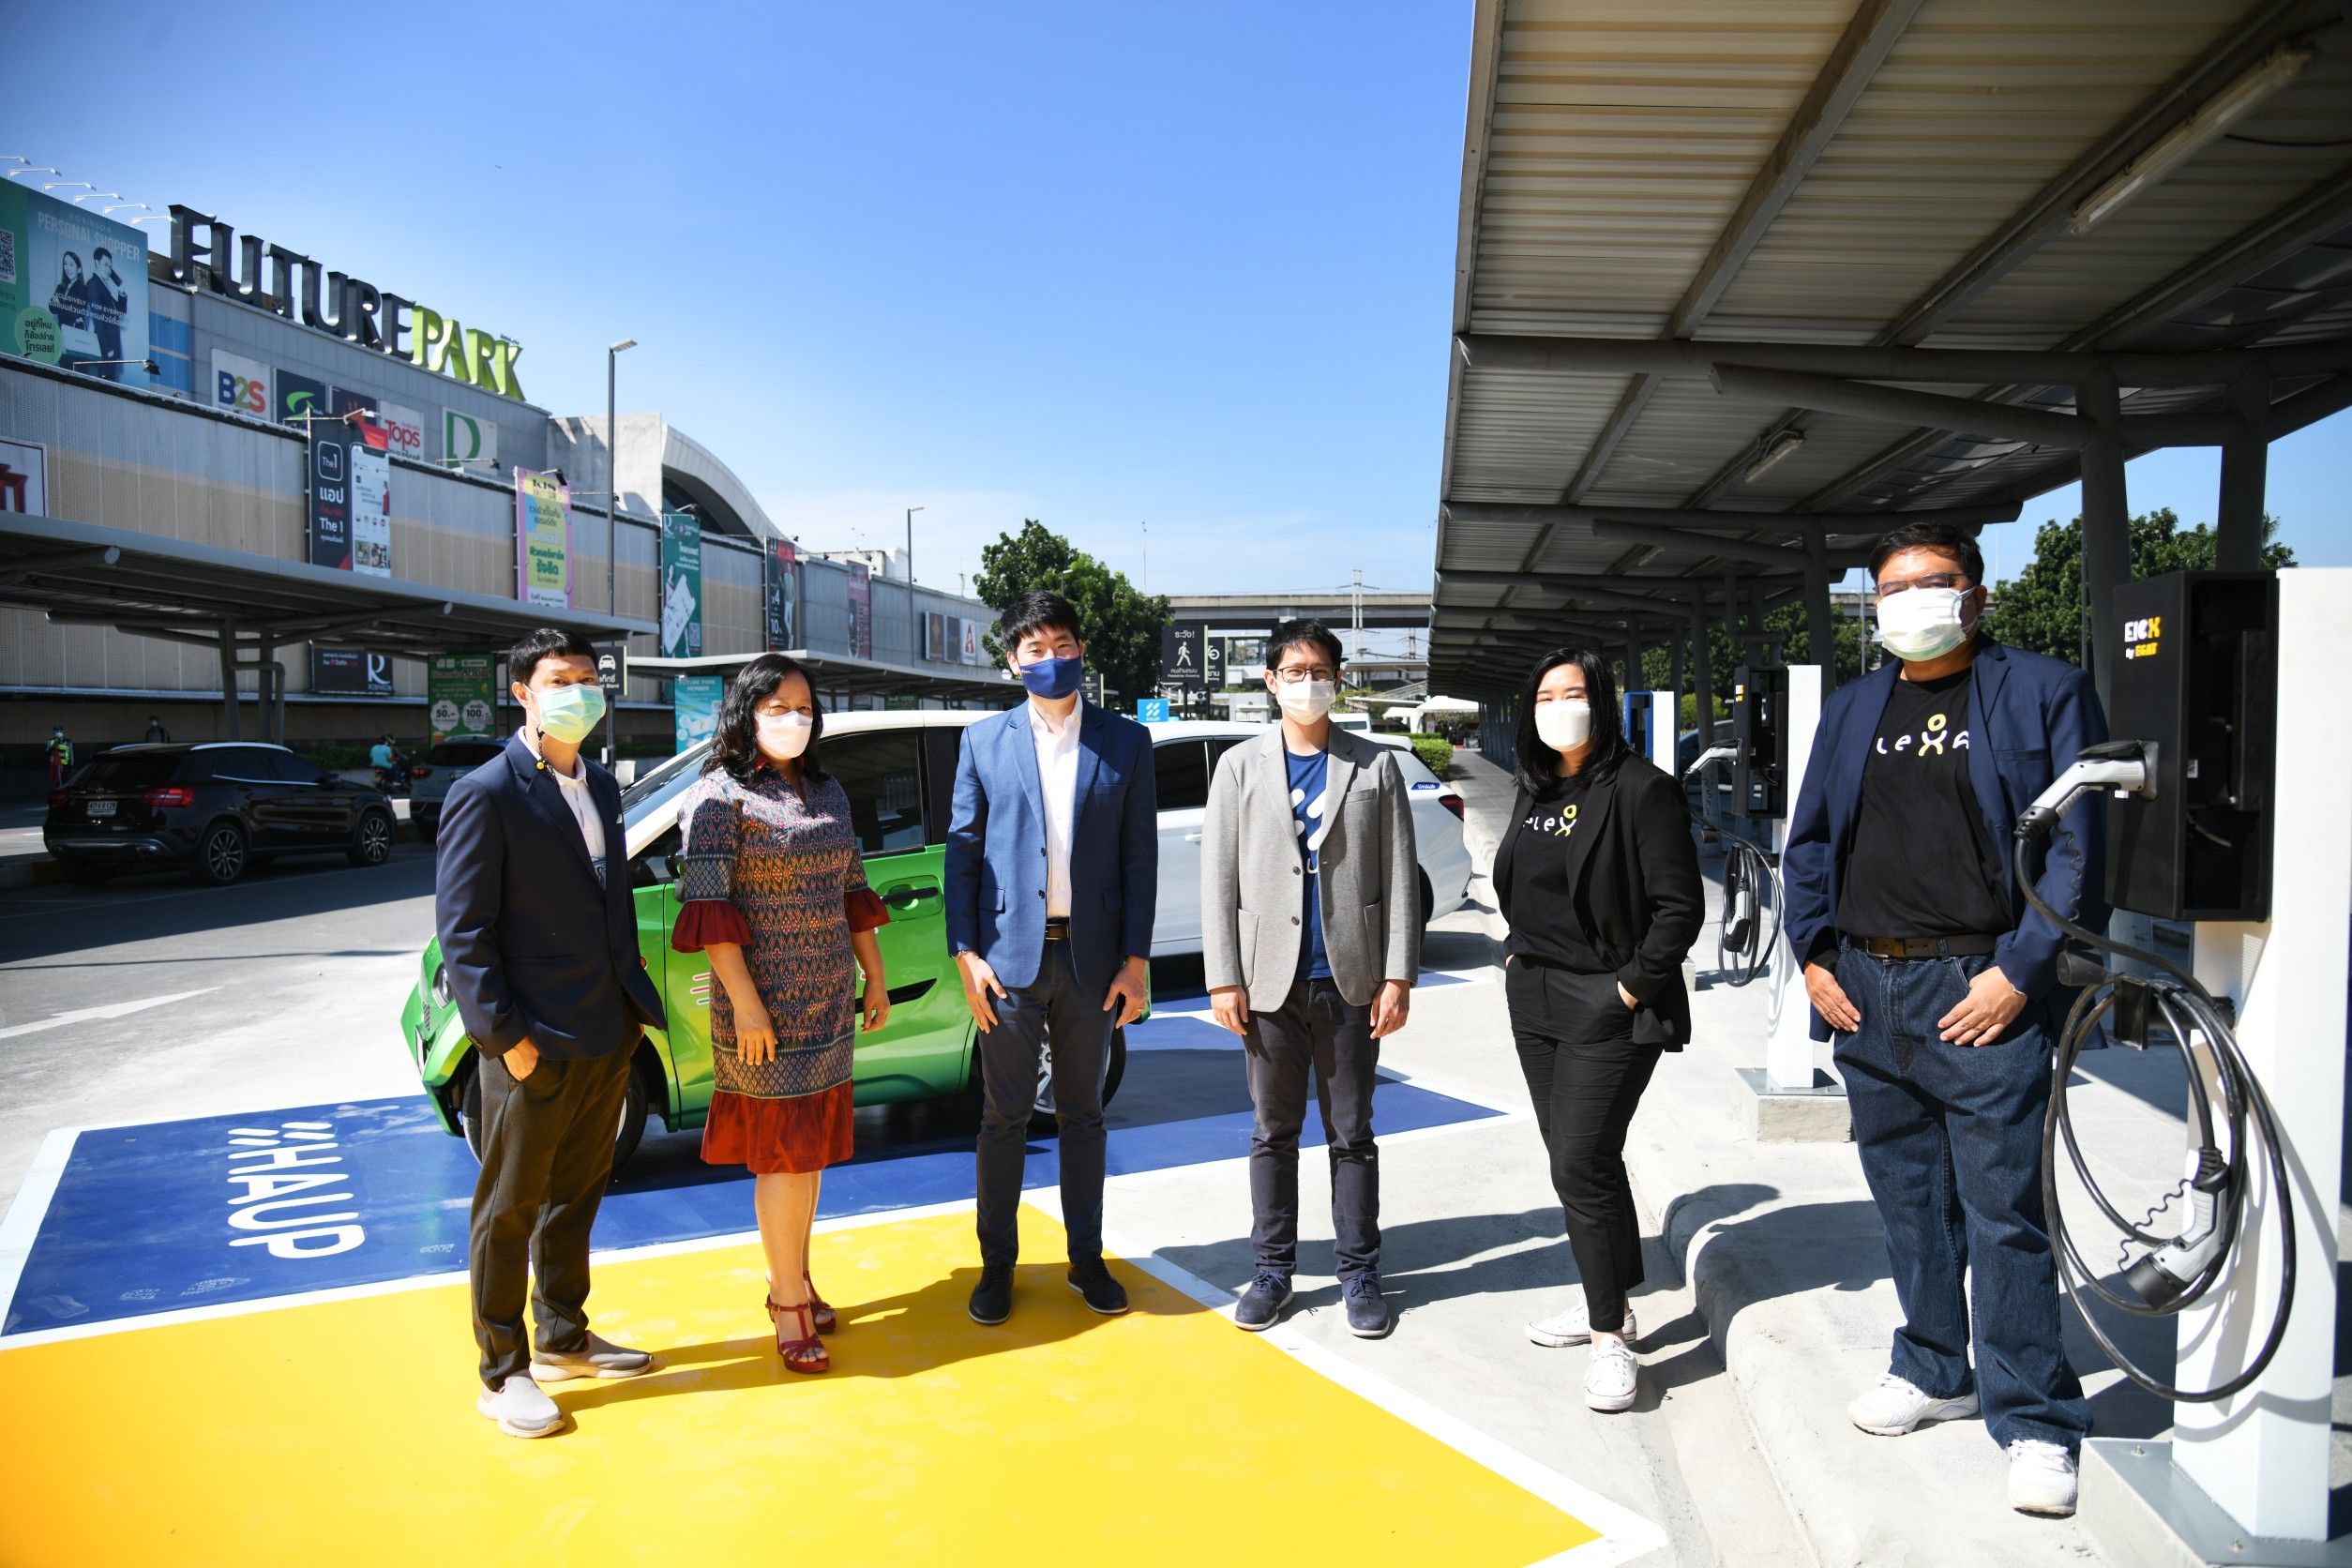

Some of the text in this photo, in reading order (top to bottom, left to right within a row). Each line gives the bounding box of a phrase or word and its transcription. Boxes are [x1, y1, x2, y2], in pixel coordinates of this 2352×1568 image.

[38, 211, 140, 263] PERSONAL SHOPPER
[53, 292, 87, 306] XCLUSIVELY
[91, 302, 102, 311] FOR
[169, 204, 525, 401] FUTURE PARK
[25, 339, 54, 353] โทรเลย!
[218, 369, 266, 414] B2S
[384, 419, 420, 450] Tops
[320, 487, 344, 504] แอป
[319, 517, 338, 532] The
[1174, 629, 1195, 639] ระวัง!
[227, 1142, 366, 1259] HAUP
